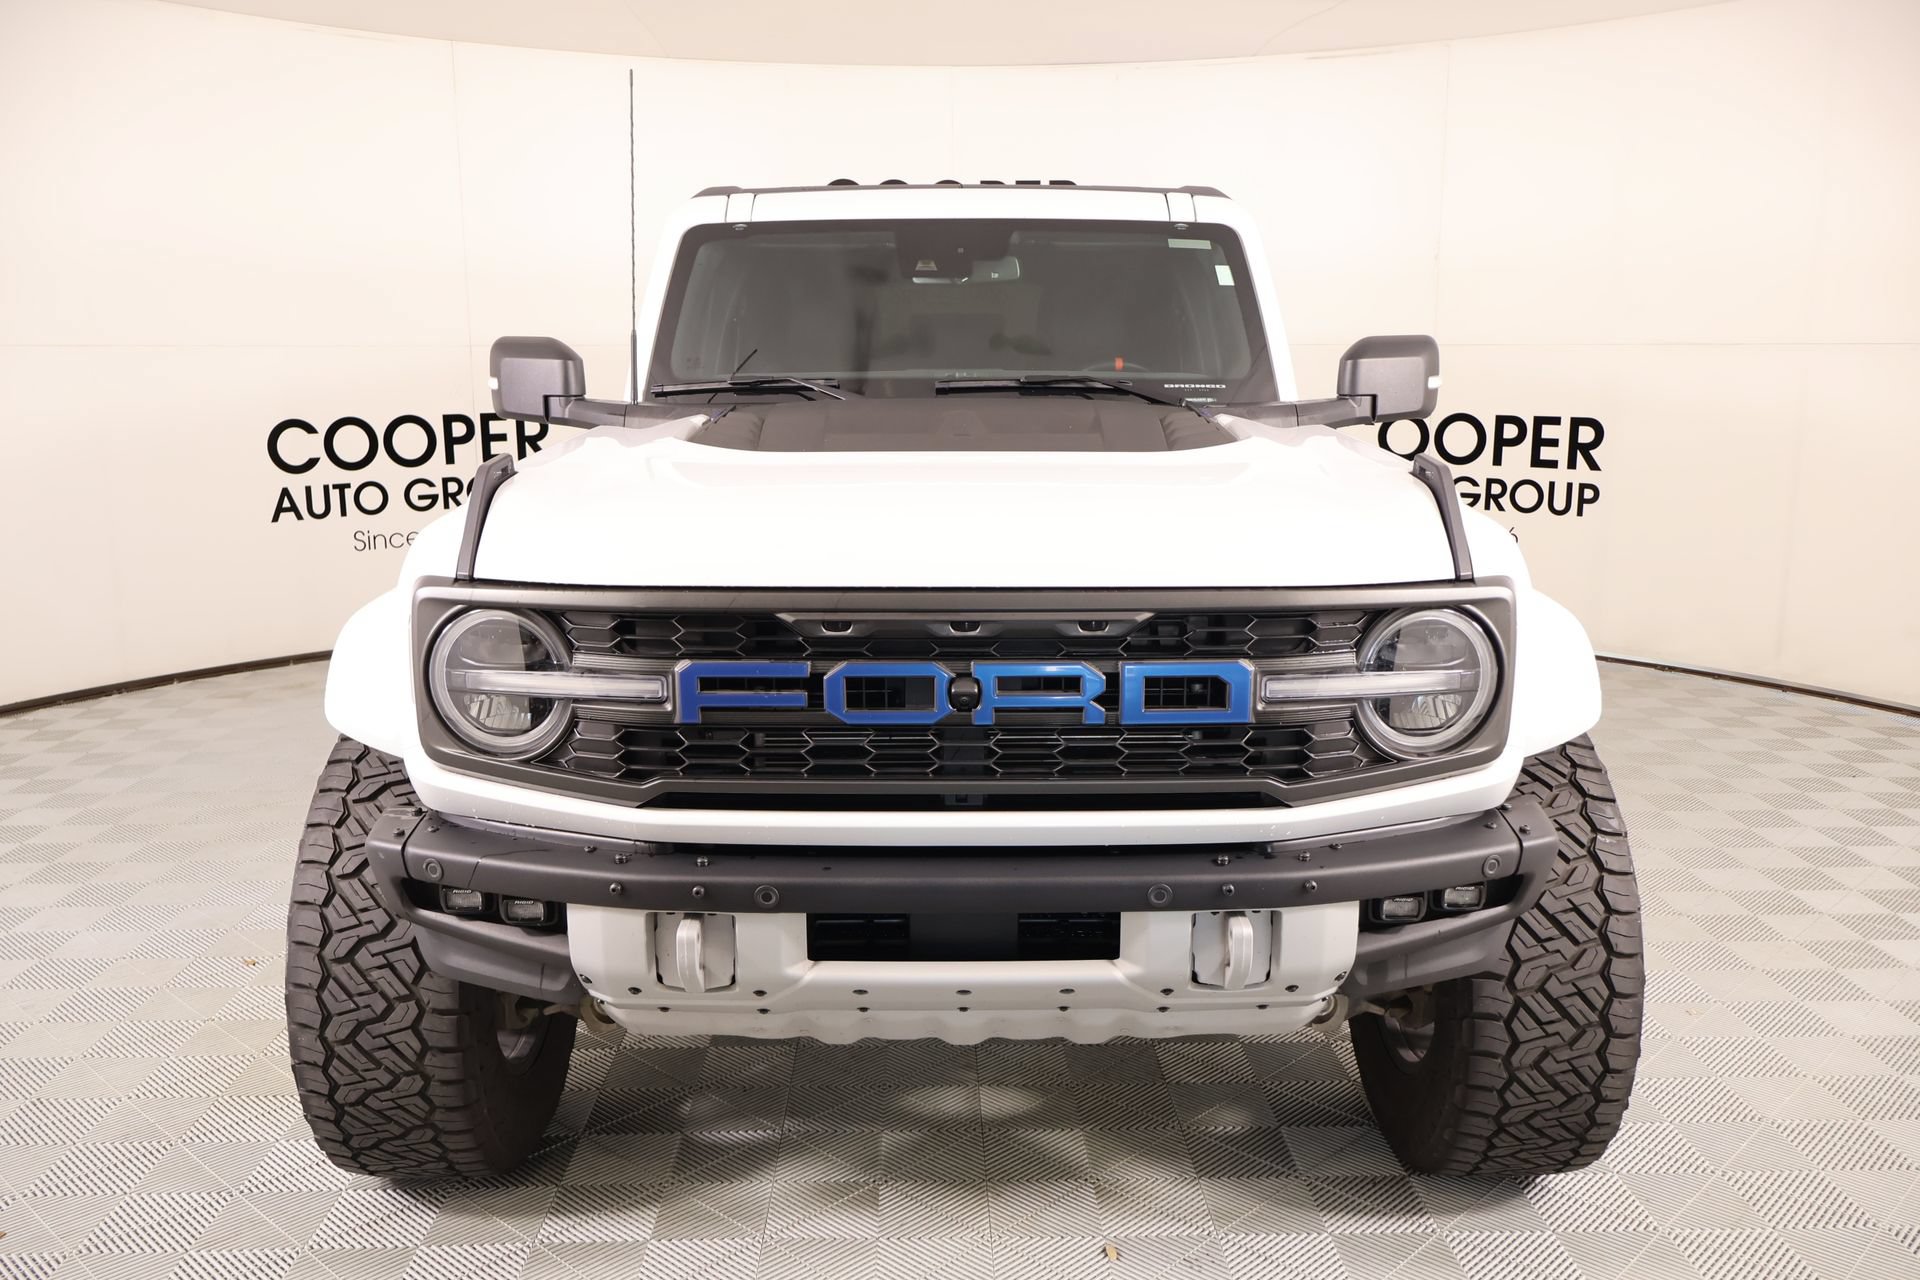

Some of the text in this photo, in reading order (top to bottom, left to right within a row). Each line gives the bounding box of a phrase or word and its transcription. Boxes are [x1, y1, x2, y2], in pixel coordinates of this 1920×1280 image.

[267, 413, 549, 474] COOPER
[1378, 412, 1605, 471] OOPER
[271, 481, 389, 523] AUTO
[674, 659, 1256, 725] FORD
